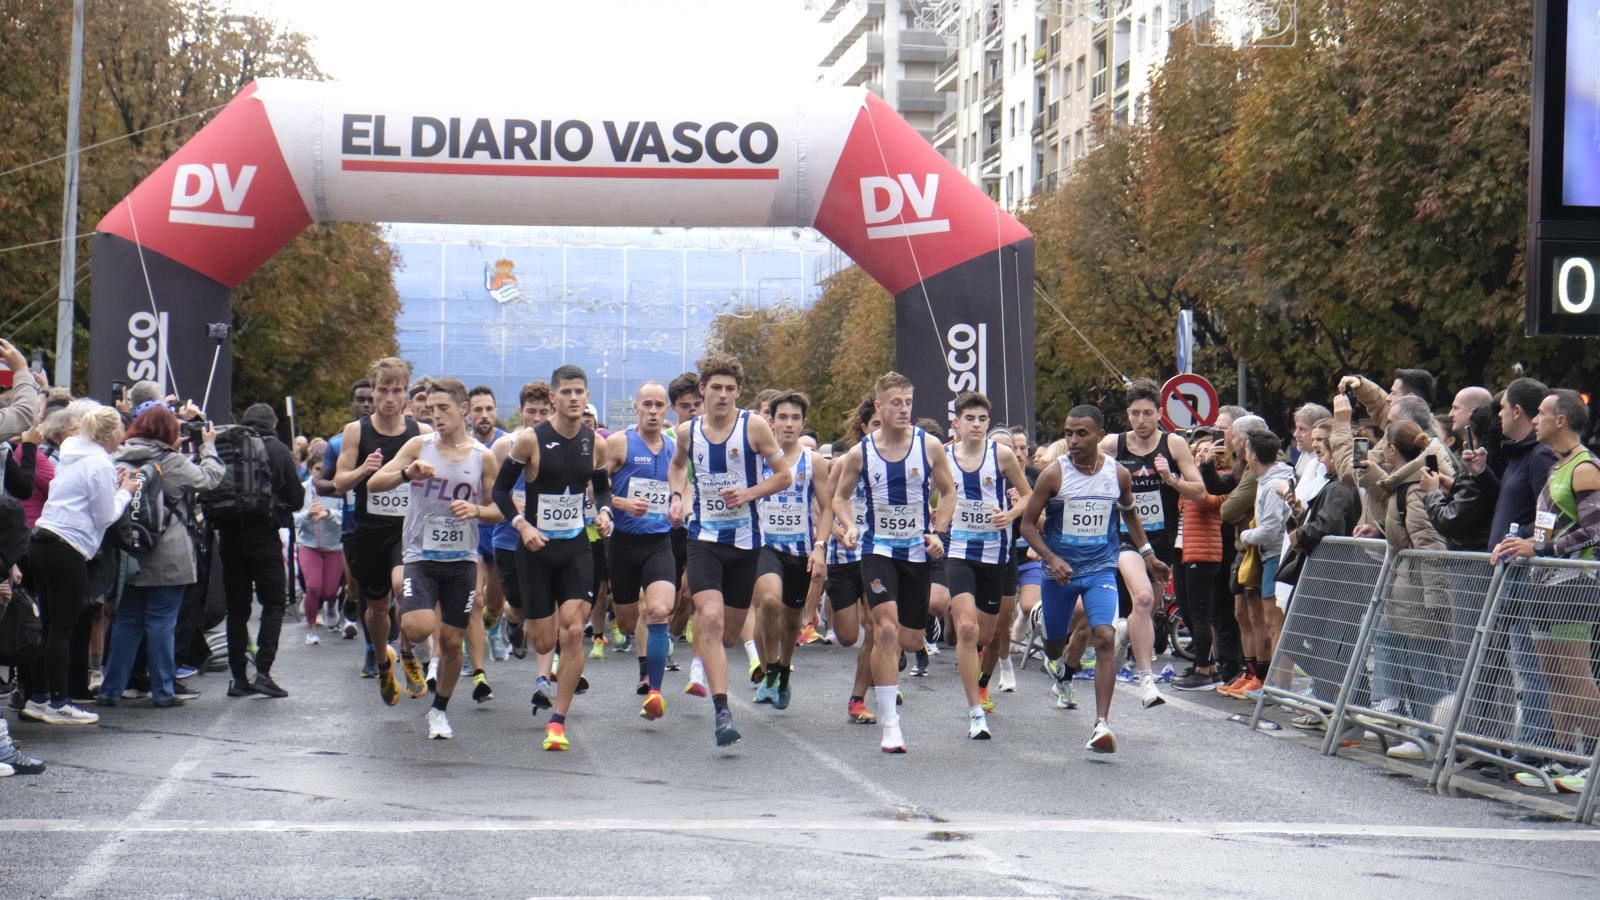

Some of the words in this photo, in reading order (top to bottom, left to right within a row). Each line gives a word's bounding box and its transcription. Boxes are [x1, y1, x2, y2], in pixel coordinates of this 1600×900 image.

[342, 114, 401, 156] EL
[411, 117, 593, 161] DIARIO
[604, 121, 779, 164] VASCO
[171, 163, 257, 212] DV
[860, 173, 939, 225] DV
[1559, 256, 1596, 314] 0
[371, 495, 409, 507] 5003
[543, 507, 579, 521] 5002
[768, 514, 802, 526] 5553
[961, 511, 993, 524] 5185
[1072, 514, 1104, 527] 5011
[880, 517, 917, 530] 5594
[431, 530, 464, 542] 5281
